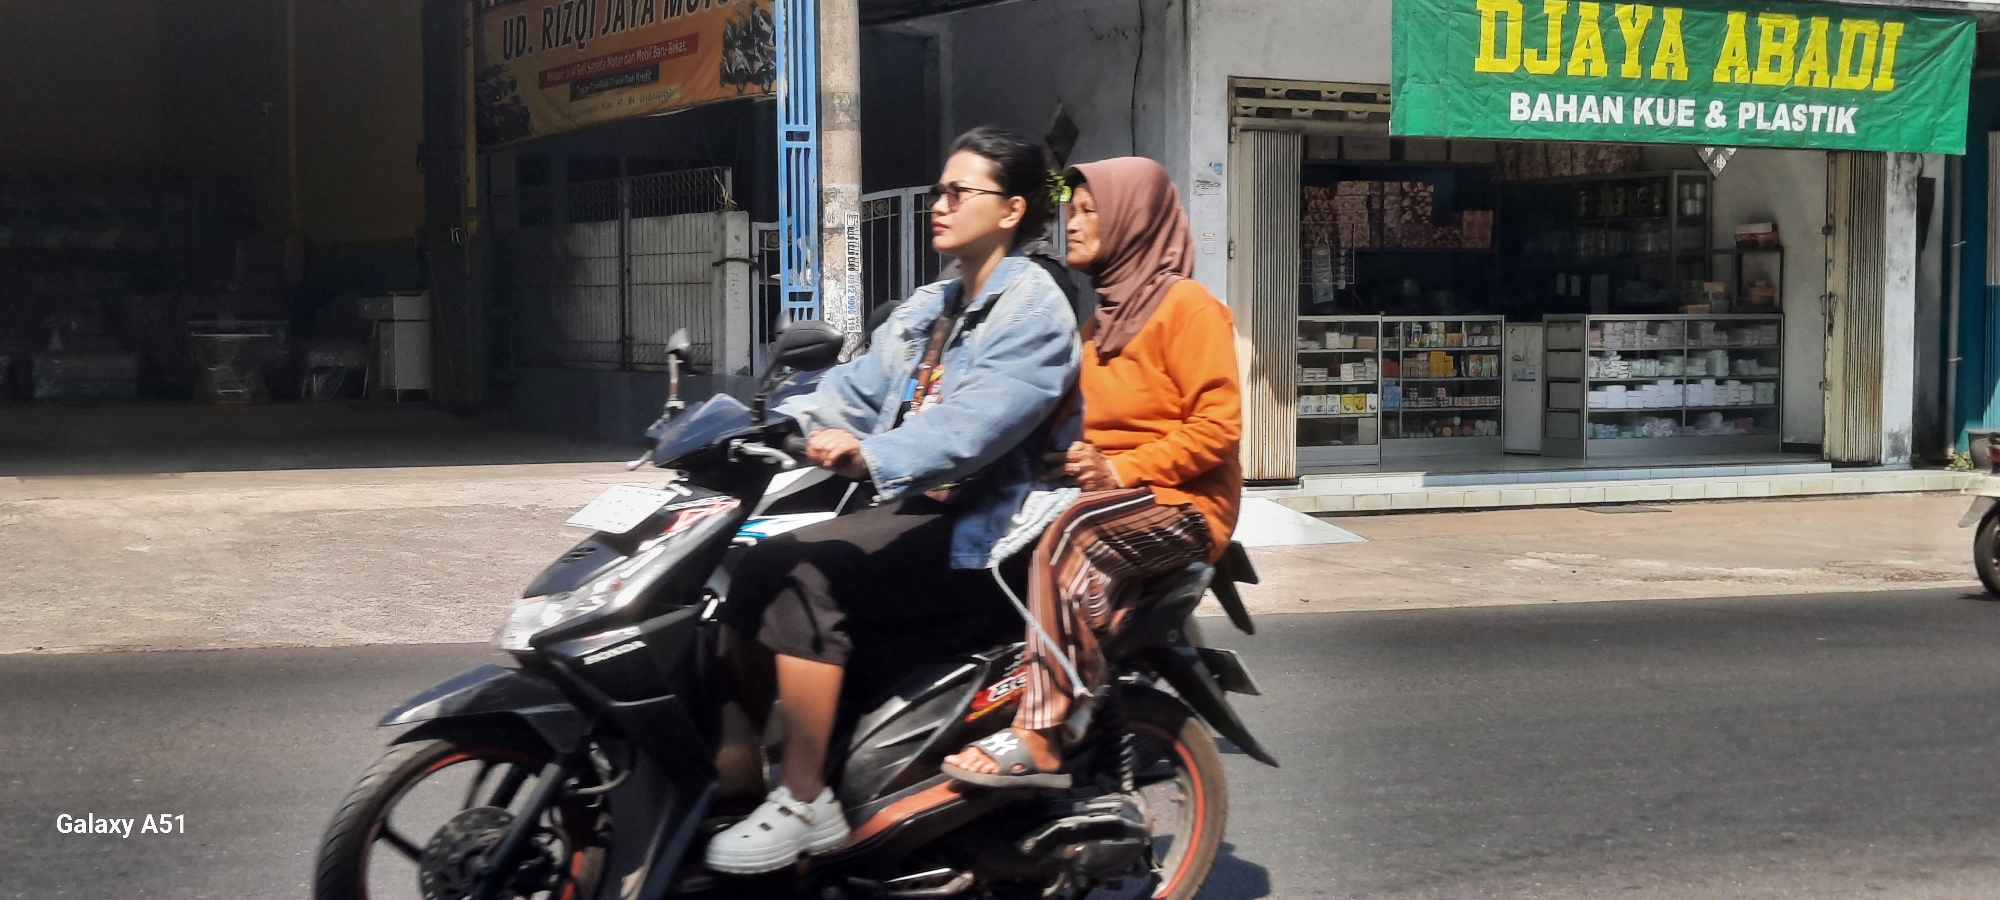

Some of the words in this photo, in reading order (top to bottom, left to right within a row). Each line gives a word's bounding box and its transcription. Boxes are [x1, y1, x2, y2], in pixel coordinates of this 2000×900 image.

[503, 14, 533, 61] UD.
[541, 0, 596, 50] RIZQI
[601, 0, 655, 36] JAYA
[1474, 0, 1689, 80] DJAYA
[1712, 10, 1905, 92] ABADI
[624, 52, 636, 65] dan
[637, 48, 652, 63] Mobil
[1509, 92, 1624, 125] BAHAN
[1633, 97, 1696, 128] KUE
[1704, 100, 1727, 129] &
[1738, 101, 1861, 134] PLASTIK
